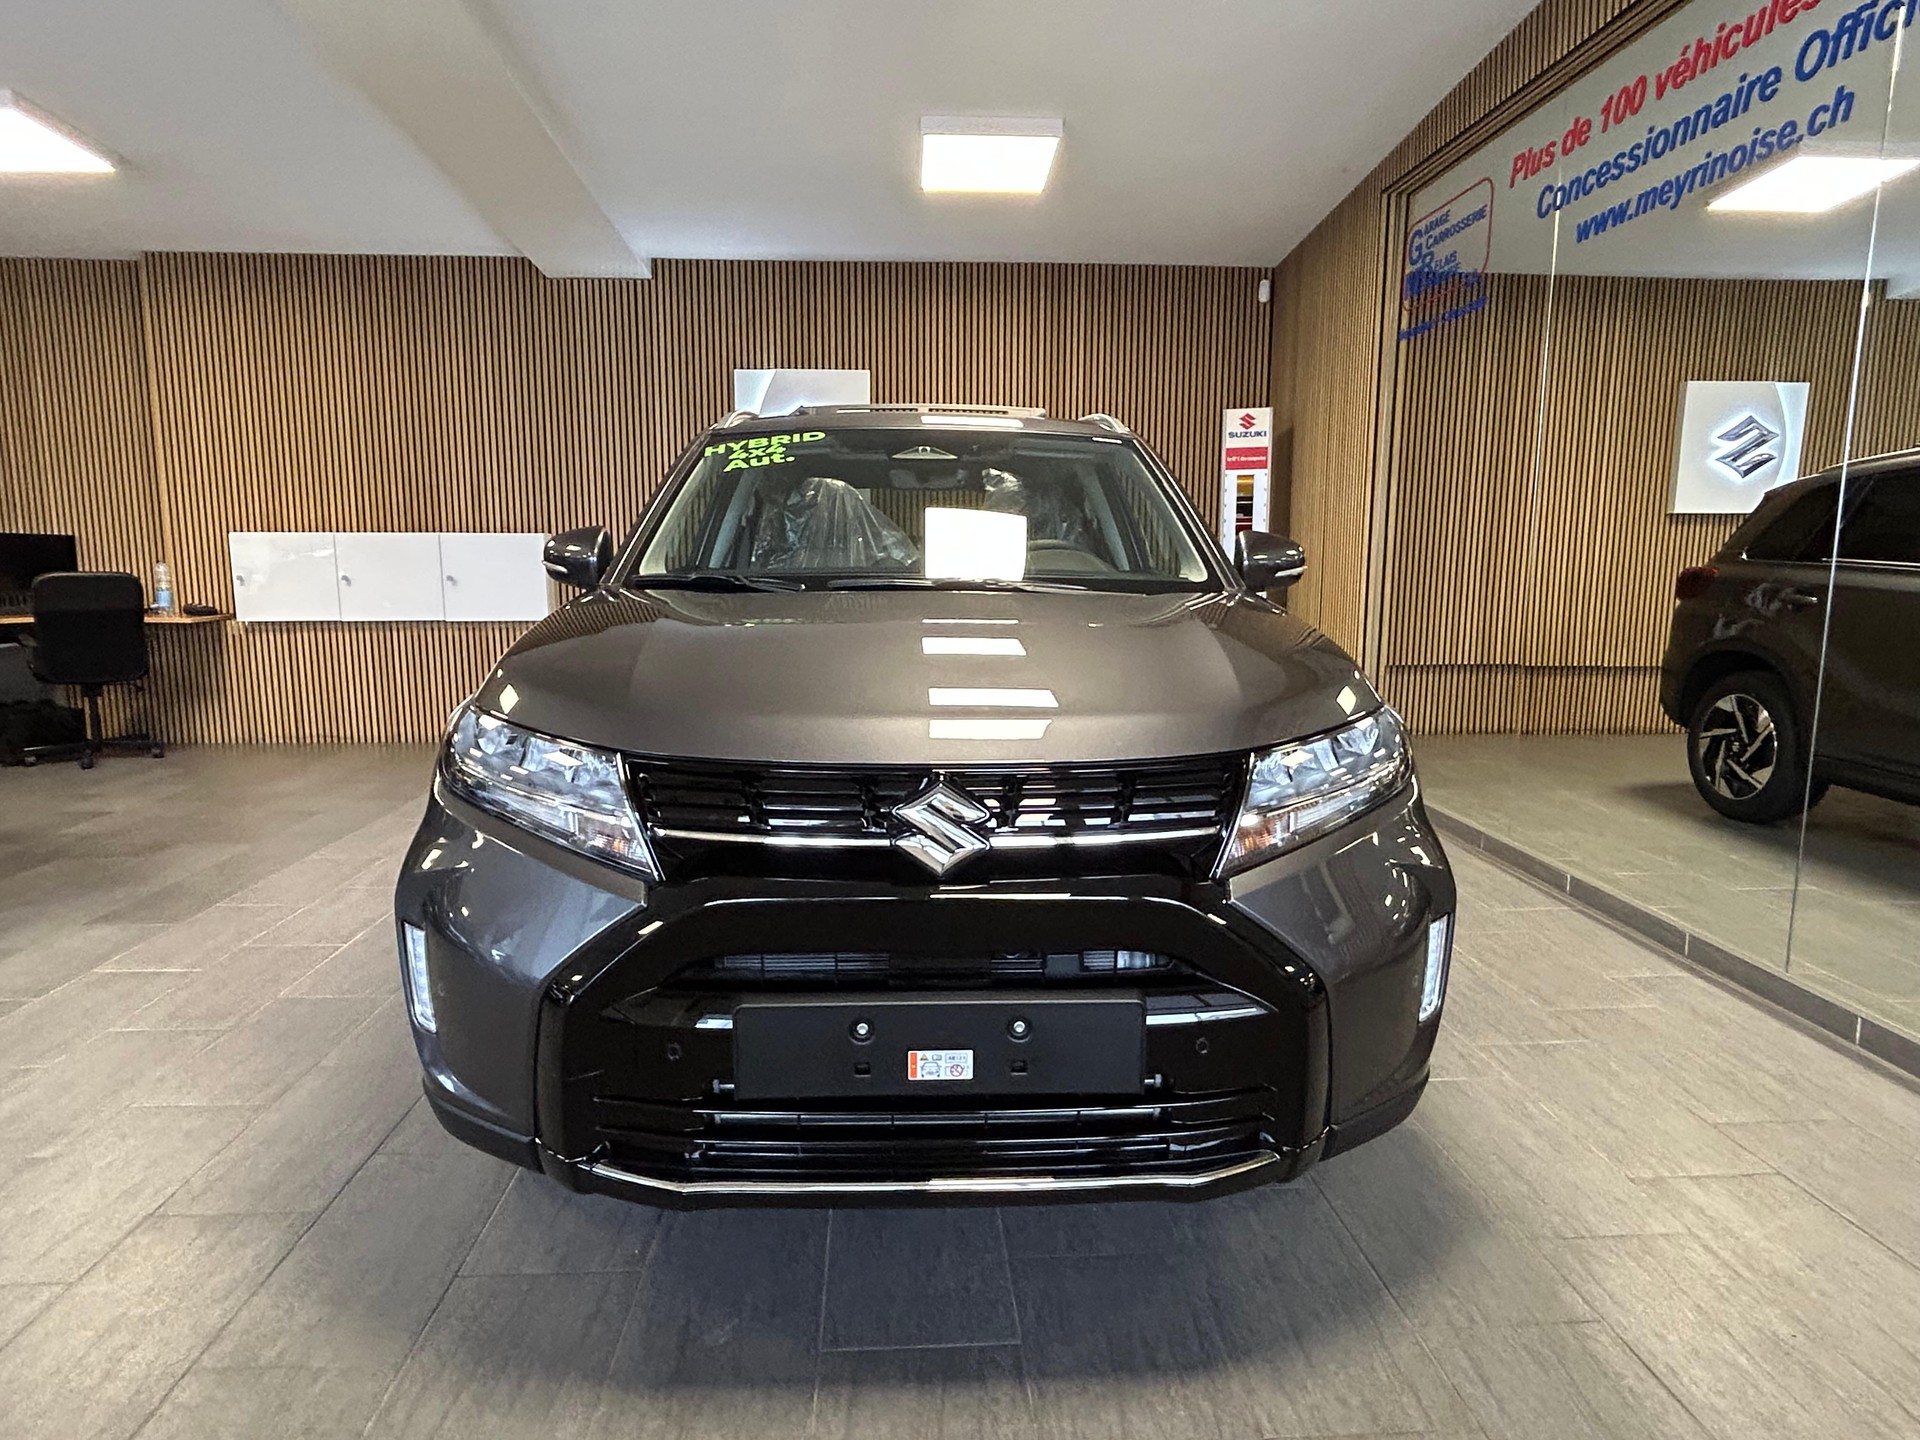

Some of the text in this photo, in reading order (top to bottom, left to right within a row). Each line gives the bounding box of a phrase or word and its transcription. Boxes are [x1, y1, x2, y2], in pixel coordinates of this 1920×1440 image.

[1509, 140, 1557, 189] Plus
[1561, 116, 1592, 157] de
[1600, 74, 1648, 134] 100
[1536, 0, 1920, 219] Concessionnaire Offici
[1576, 84, 1855, 243] www.meyrinoise.ch
[704, 431, 826, 457] HYBRID
[723, 453, 796, 473] Aut.
[1228, 430, 1267, 439] SUZUKI
